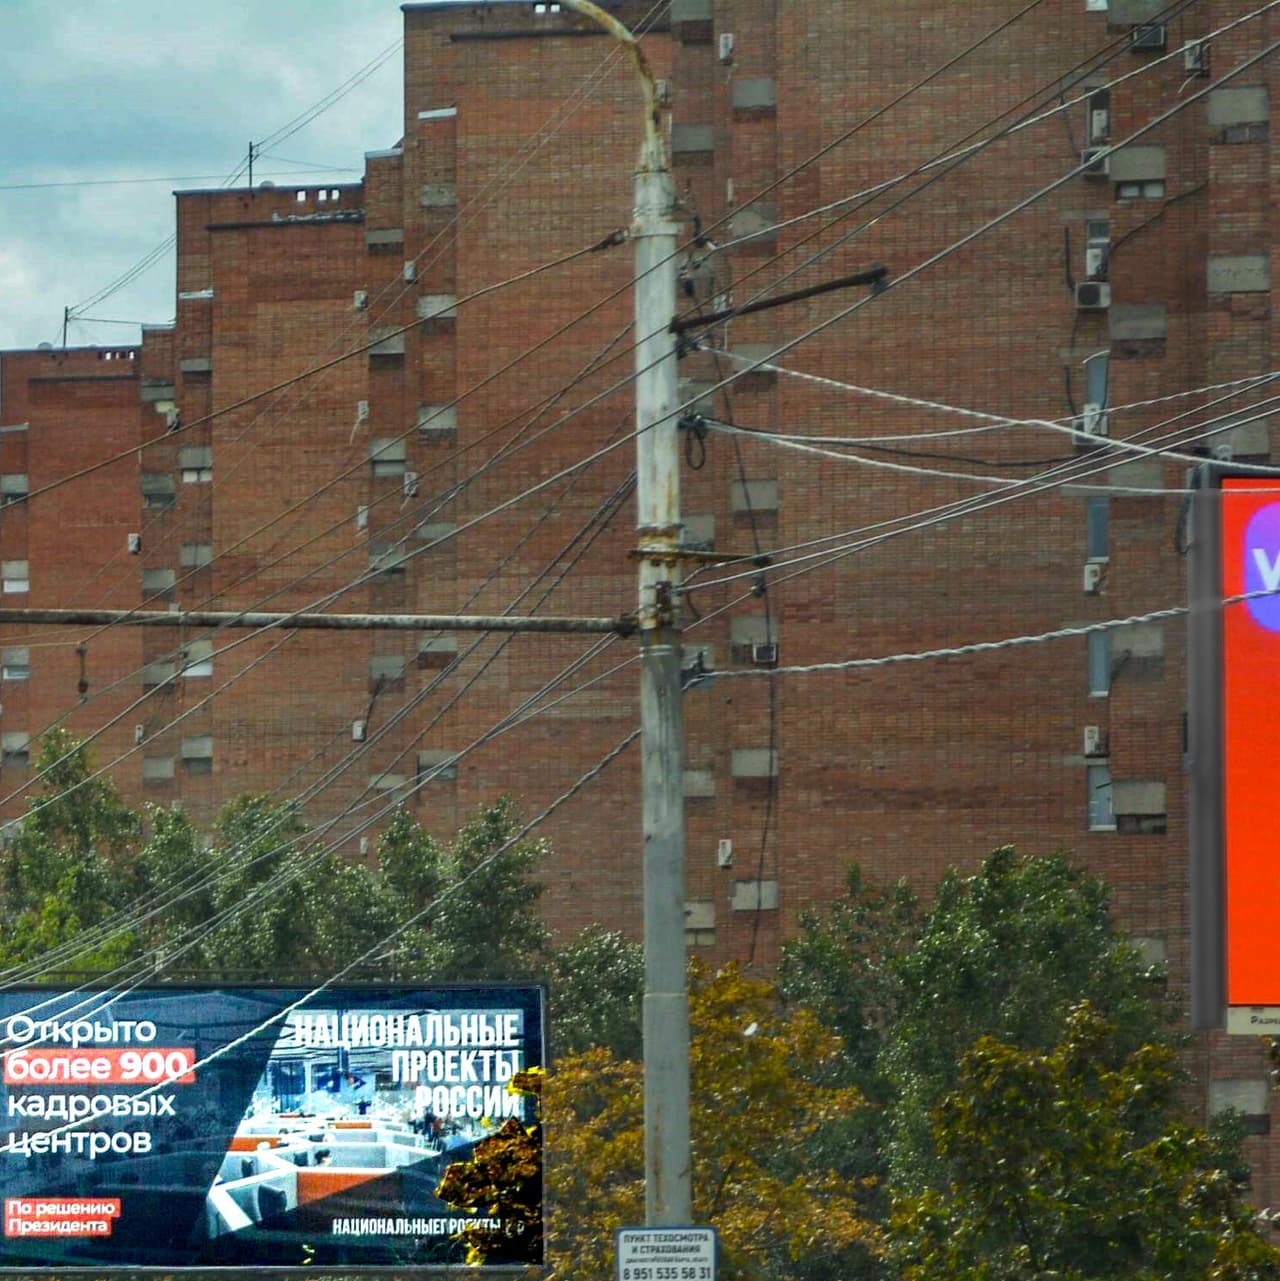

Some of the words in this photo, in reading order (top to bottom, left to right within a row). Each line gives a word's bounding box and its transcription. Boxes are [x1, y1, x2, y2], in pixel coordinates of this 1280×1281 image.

[7, 1015, 157, 1048] Открыто
[295, 1014, 519, 1049] НАЦИОНАЛЬНЫЕ
[7, 1051, 112, 1079] более
[120, 1052, 188, 1079] 900
[392, 1050, 519, 1082] ПРОЕКТЫ
[9, 1094, 176, 1121] кадровых
[415, 1085, 520, 1118] РОССИИ
[9, 1131, 152, 1159] центров
[8, 1201, 32, 1214] По
[36, 1202, 116, 1216] решению
[8, 1218, 108, 1235] Президента
[624, 1268, 630, 1280] 8
[633, 1268, 652, 1280] 951
[656, 1267, 678, 1279] 535
[681, 1267, 696, 1279] 58
[699, 1267, 711, 1279] 31
